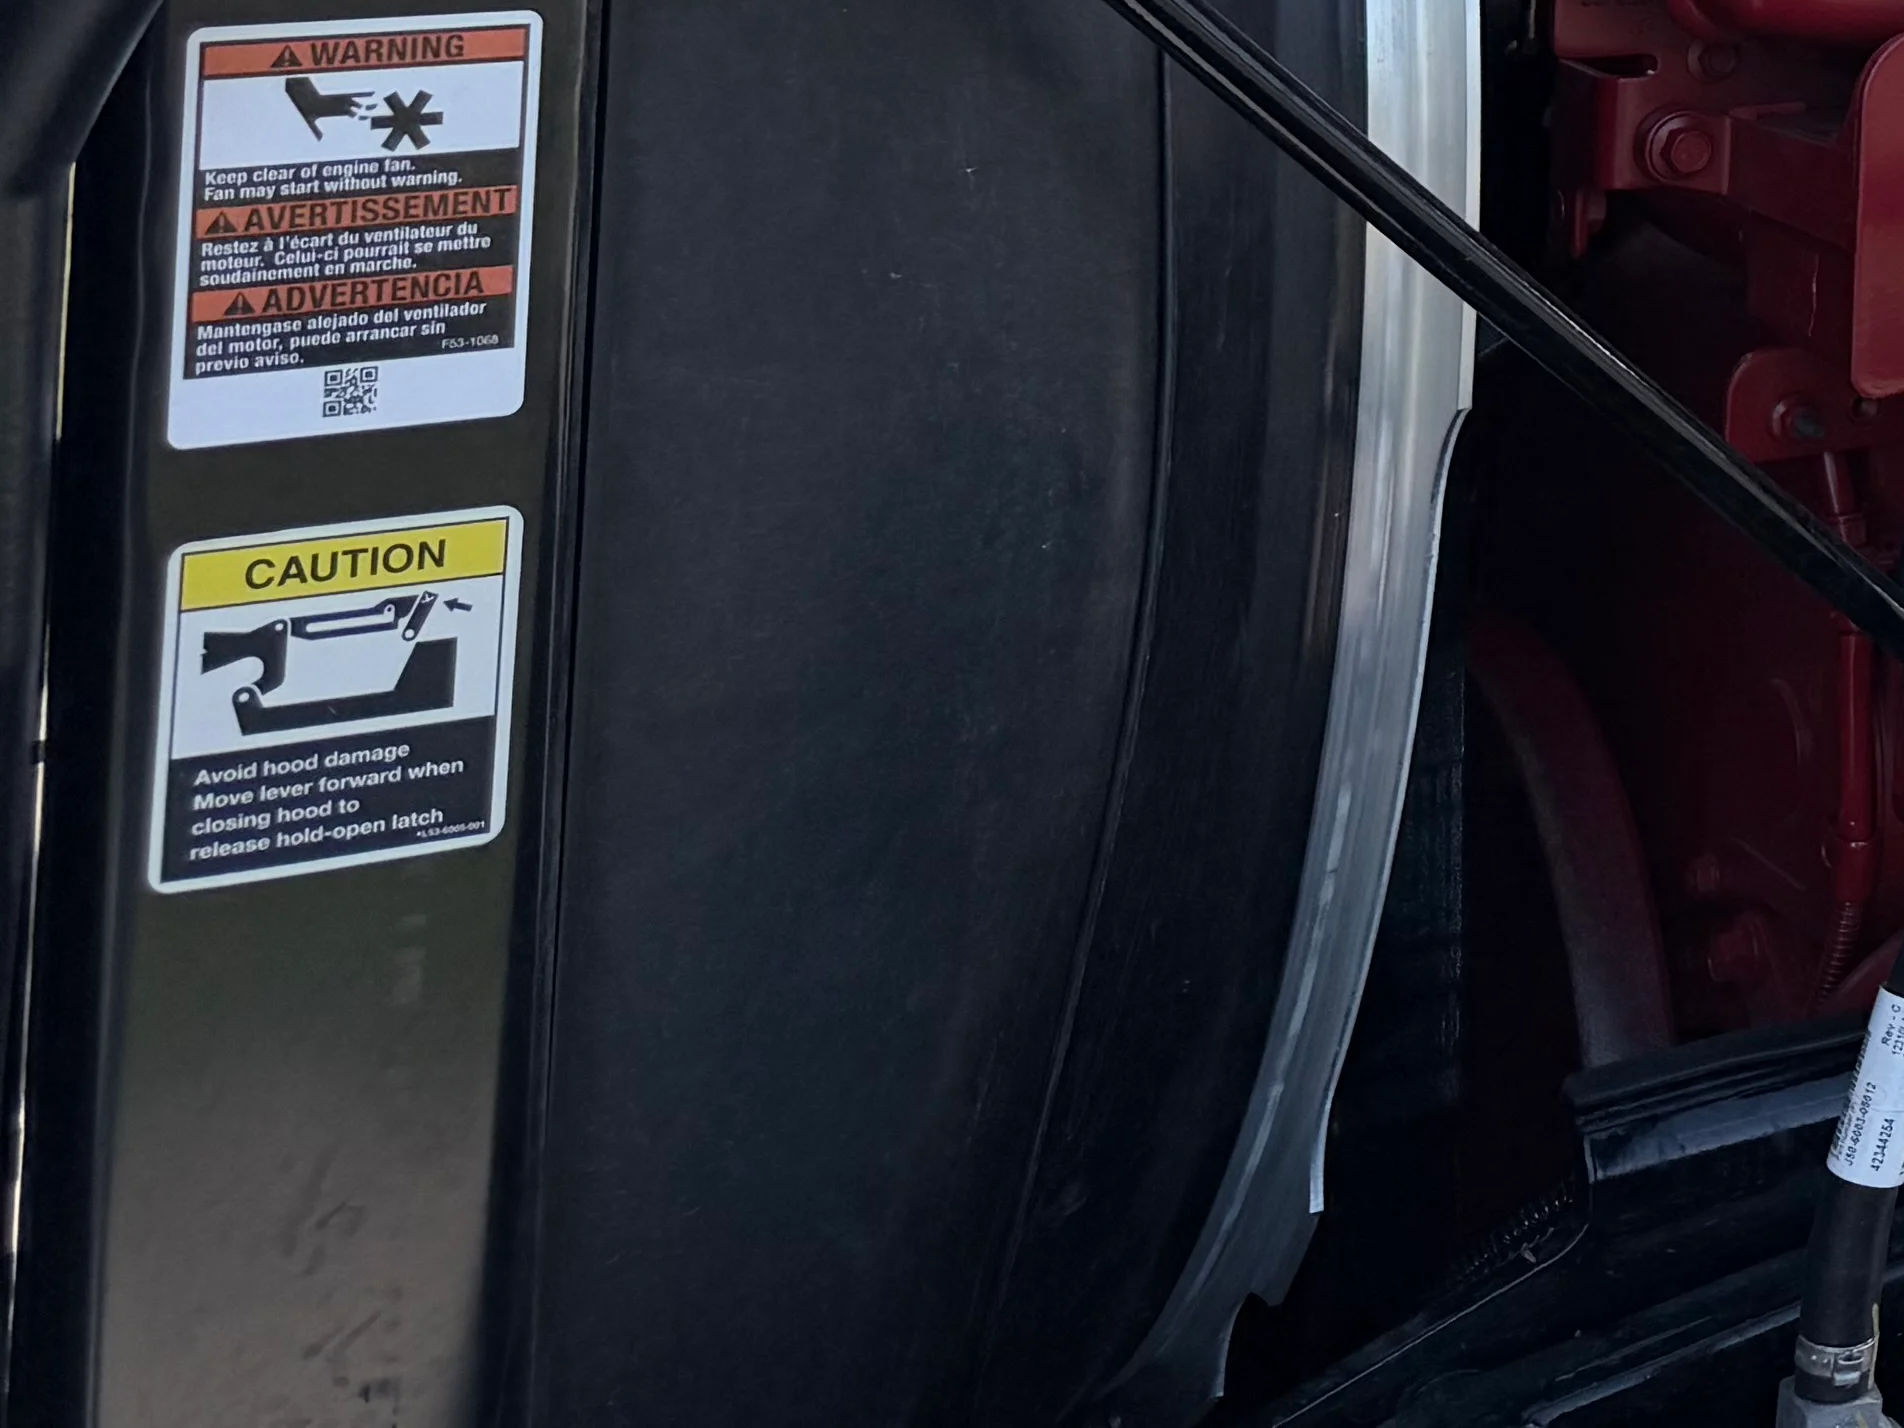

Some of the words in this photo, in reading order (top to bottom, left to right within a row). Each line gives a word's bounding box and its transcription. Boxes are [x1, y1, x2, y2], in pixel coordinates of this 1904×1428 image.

[311, 34, 465, 65] WARNING
[203, 186, 234, 201] Fan
[239, 185, 275, 200] may
[280, 181, 319, 195] start
[324, 175, 386, 192] without
[391, 170, 462, 189] warning.
[204, 169, 247, 186] Keep
[252, 166, 294, 181] clear
[300, 165, 317, 178] of
[321, 161, 378, 179] engine
[384, 158, 416, 172] fan.
[243, 188, 511, 232] AVERTISSEMENT
[200, 255, 264, 271] moteur.
[274, 248, 338, 265] Celui-ci
[343, 242, 409, 262] pourrait
[414, 242, 432, 252] se
[437, 235, 491, 251] mettre
[201, 239, 258, 256] Restez
[338, 231, 359, 245] du
[364, 223, 451, 242] ventilateur
[457, 221, 478, 234] du
[199, 264, 319, 287] soudainement
[324, 263, 345, 275] en
[349, 256, 417, 273] marche.
[261, 271, 484, 313] ADVERTENCIA
[306, 312, 368, 332] alejado
[373, 309, 398, 323] del
[403, 301, 486, 321] ventilador
[196, 341, 223, 357] del
[228, 336, 282, 356] motor,
[289, 330, 340, 350] puede
[345, 323, 416, 342] arrancar
[421, 321, 445, 335] sin
[195, 356, 249, 375] previo
[254, 350, 304, 367] aviso.
[244, 538, 446, 591] CAUTION
[194, 762, 257, 786] Avoid
[262, 753, 318, 776] hood
[323, 740, 410, 770] damage
[192, 786, 253, 811] Move
[259, 778, 313, 801] lever
[318, 765, 402, 792] forward
[407, 756, 464, 779] when
[189, 834, 270, 861] release
[276, 816, 385, 849] hold-open
[391, 806, 444, 830] latch
[190, 808, 271, 838] closing
[277, 799, 332, 823] hood
[338, 796, 360, 814] to
